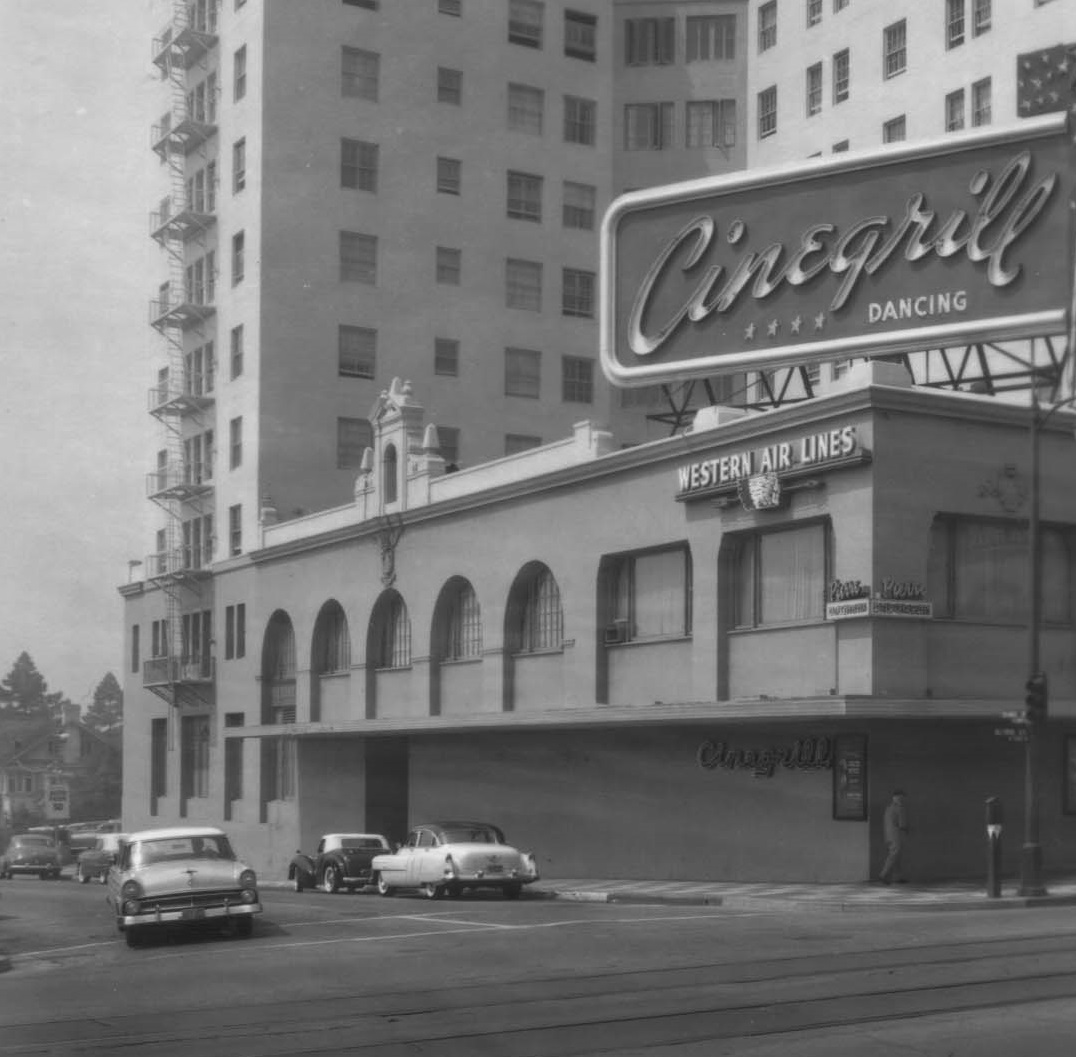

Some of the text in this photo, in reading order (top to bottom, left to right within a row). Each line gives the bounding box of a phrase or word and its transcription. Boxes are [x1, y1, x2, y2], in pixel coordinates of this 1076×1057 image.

[628, 150, 1057, 356] Cinegrill
[868, 290, 968, 323] DANCING
[679, 426, 857, 491] WESTERN AIR LINES
